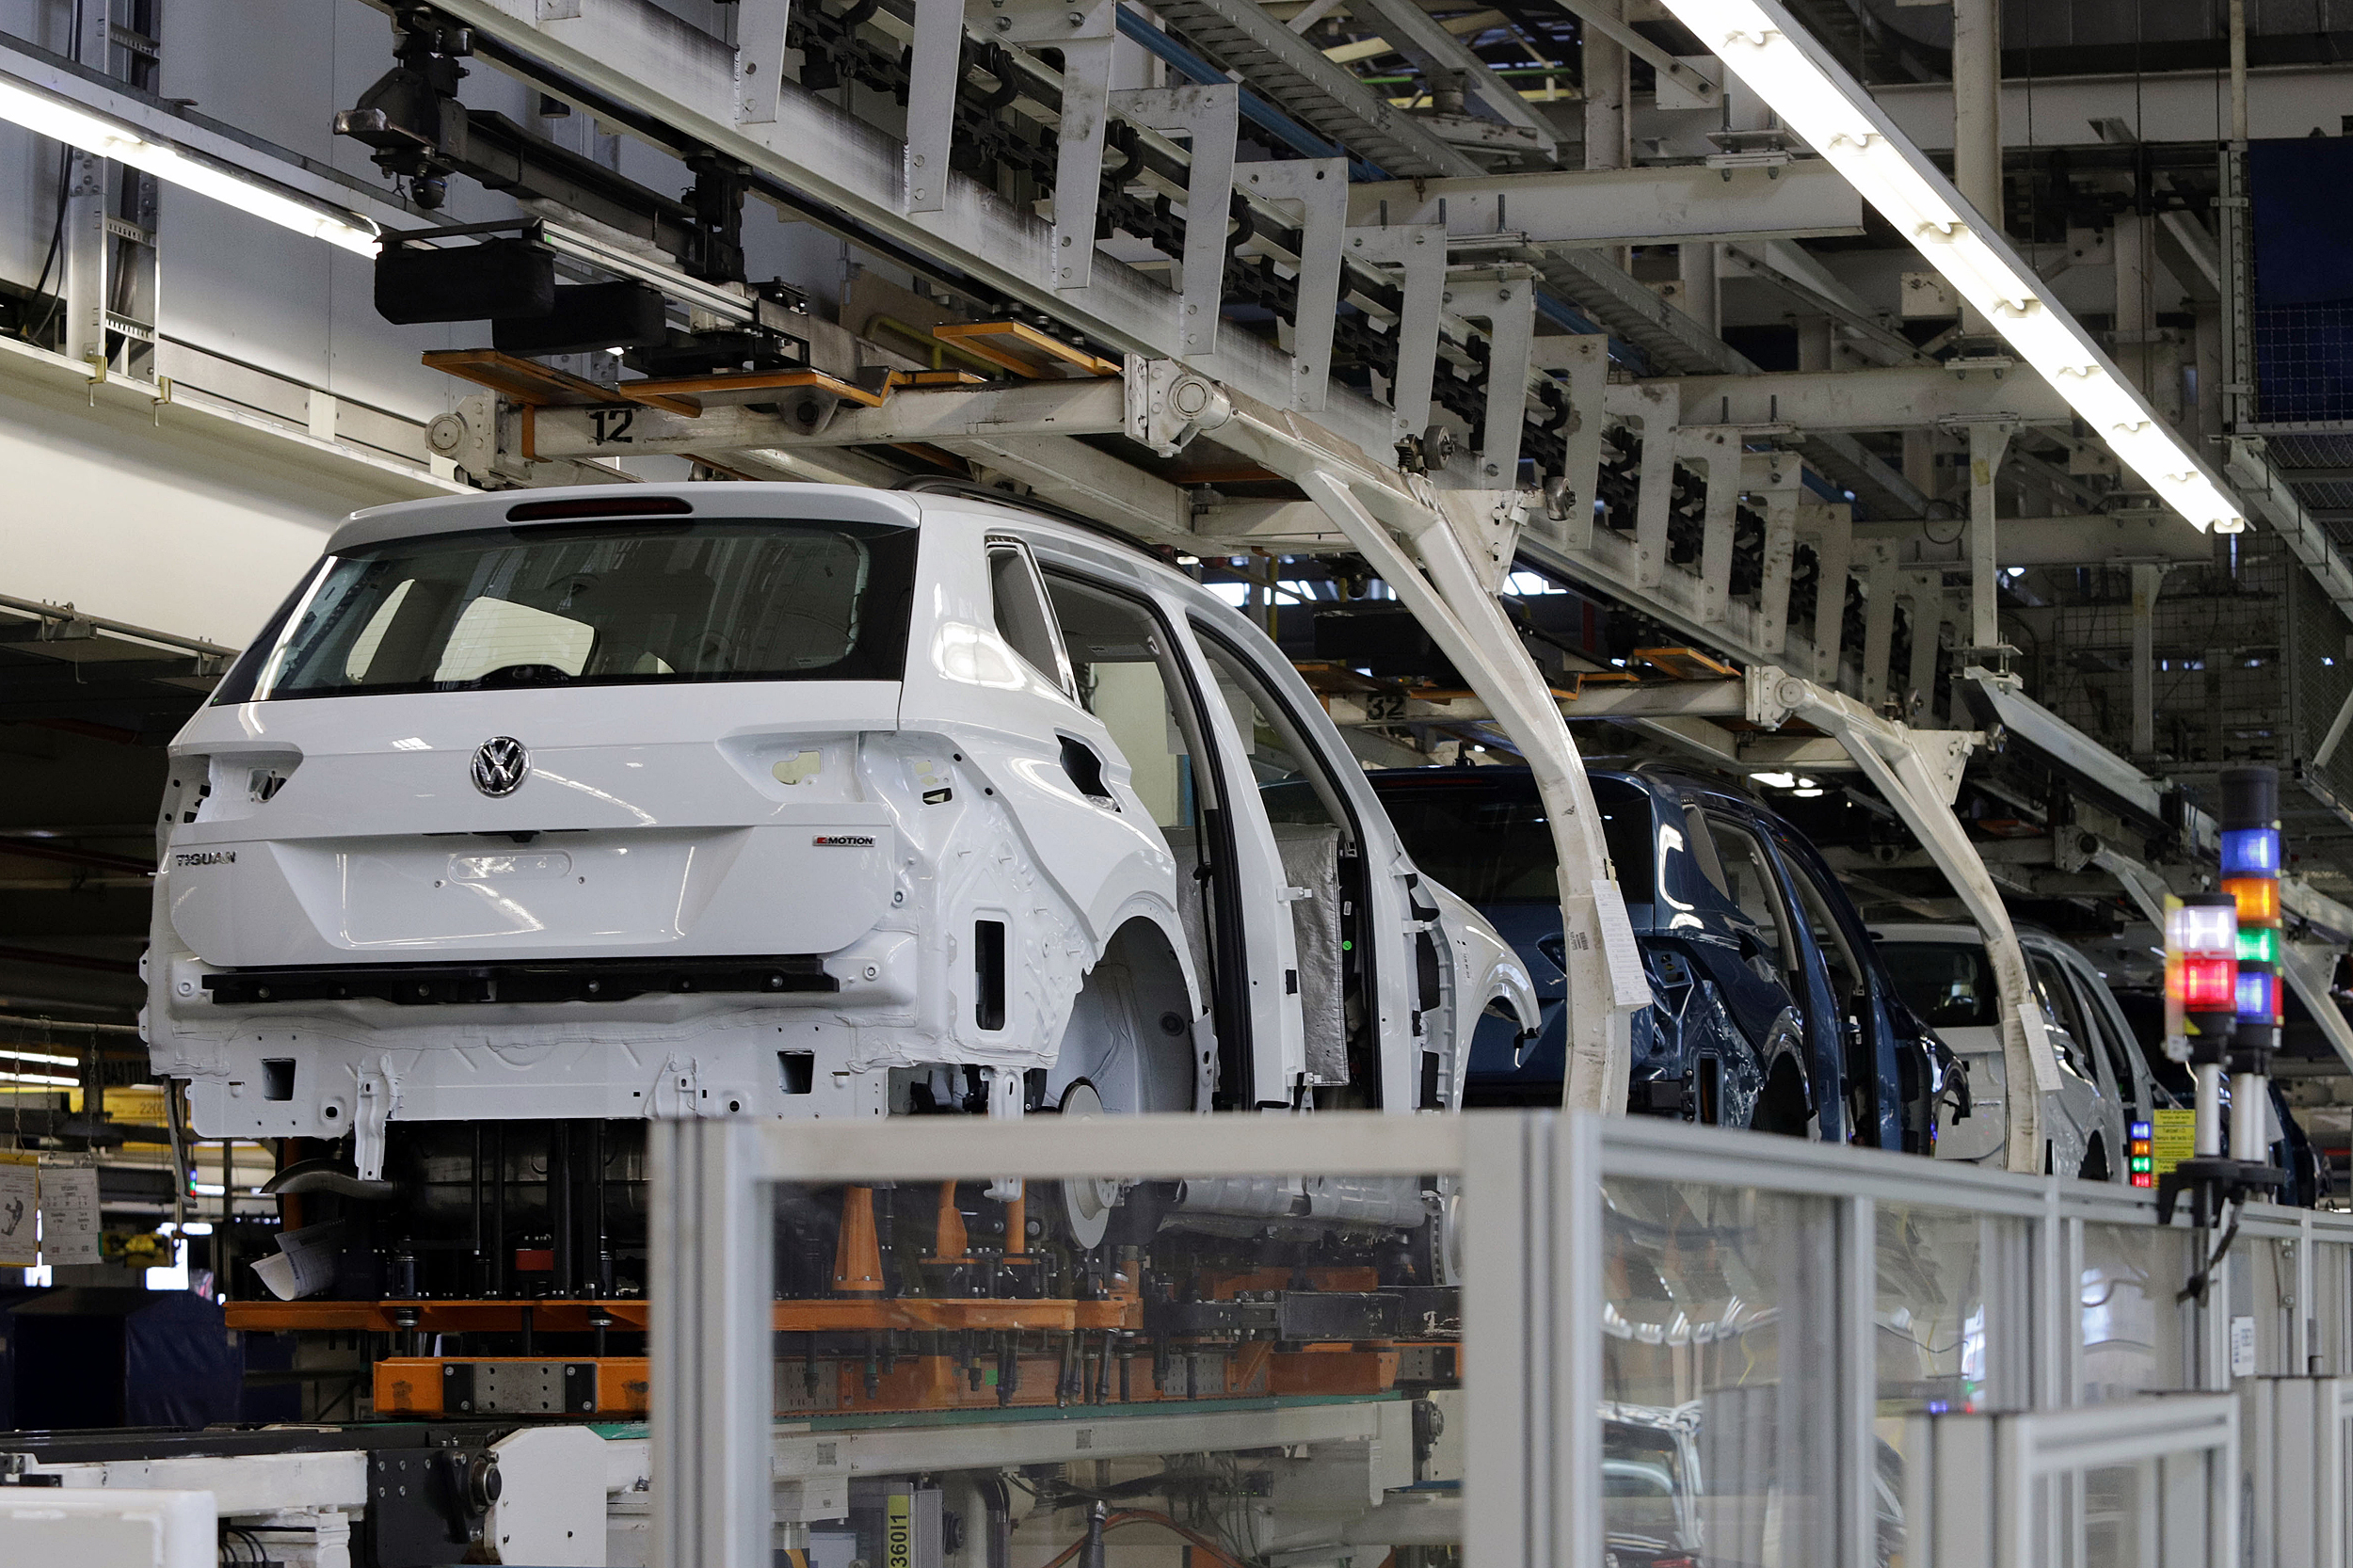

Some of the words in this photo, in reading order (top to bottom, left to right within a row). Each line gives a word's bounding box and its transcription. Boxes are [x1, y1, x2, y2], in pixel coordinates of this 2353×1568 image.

[589, 409, 632, 444] 12
[1367, 695, 1405, 720] 32
[176, 851, 236, 867] TIGUAN
